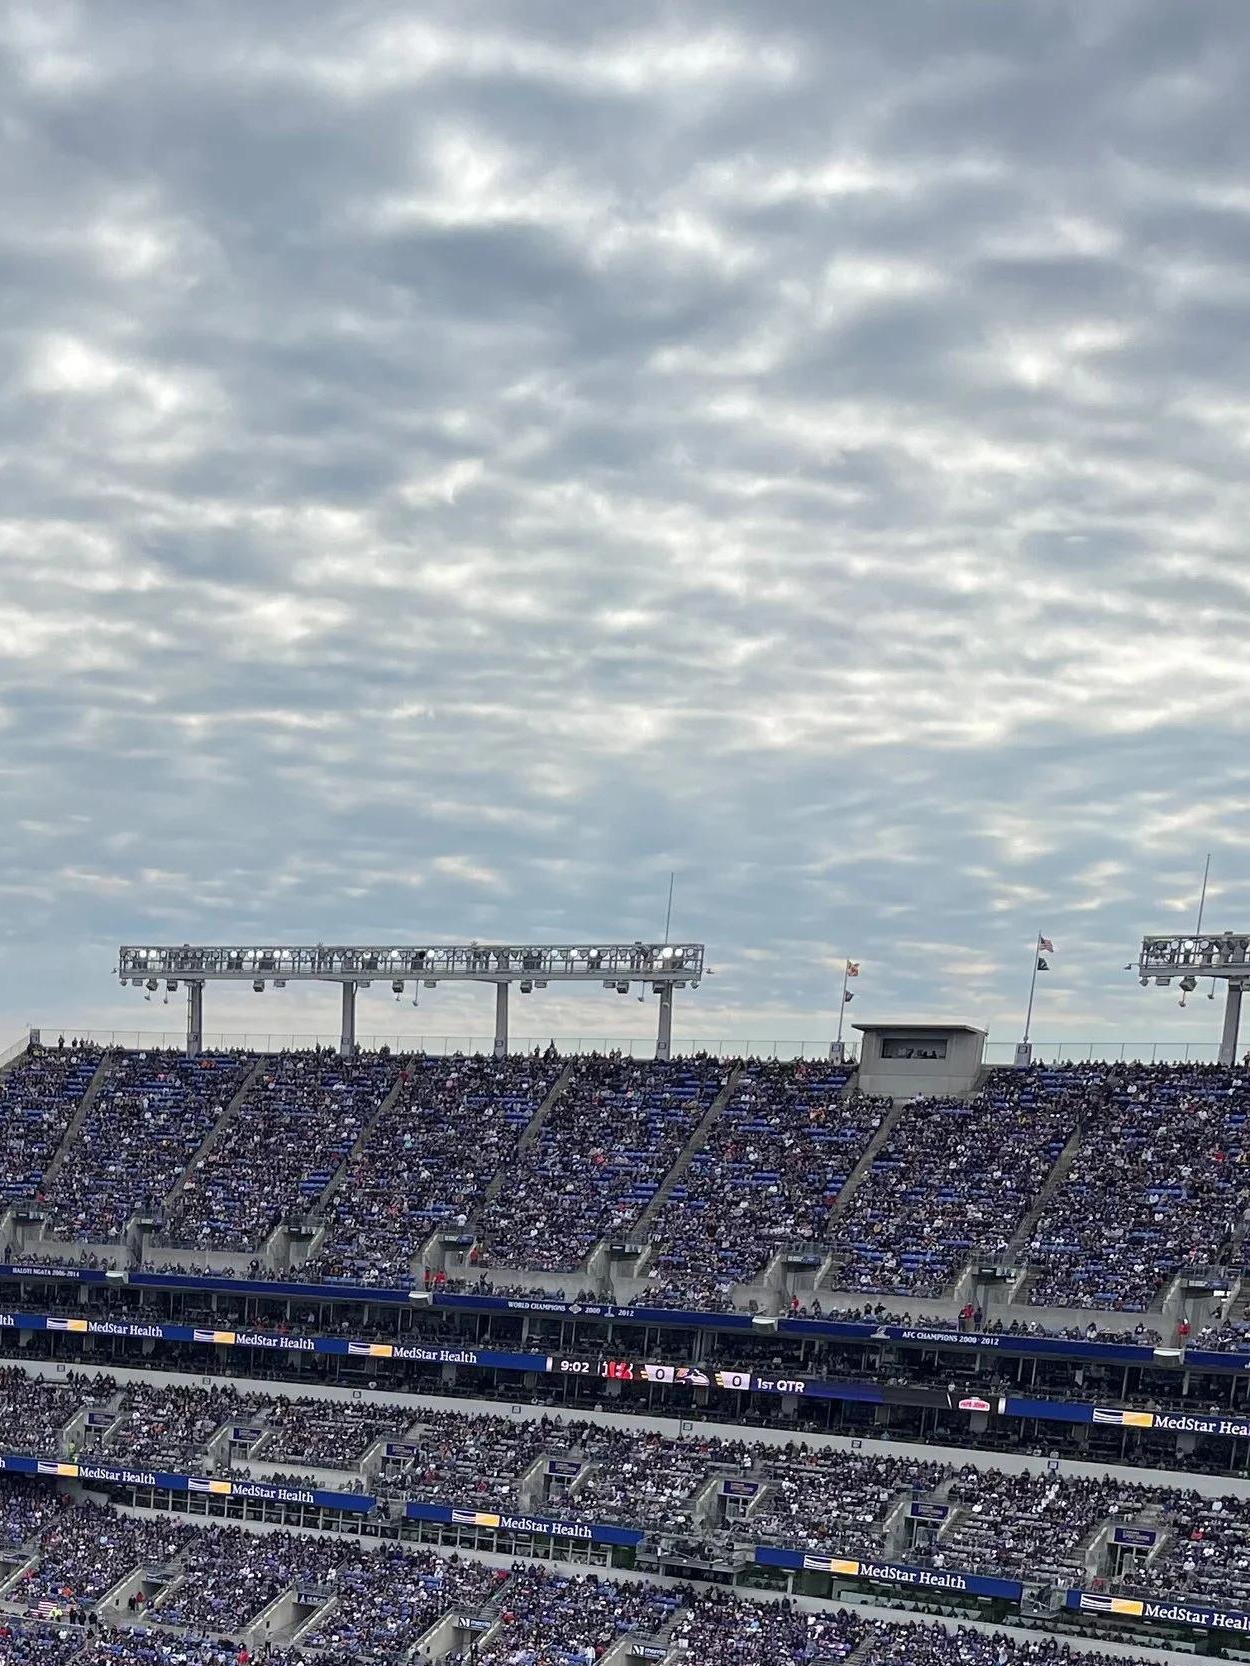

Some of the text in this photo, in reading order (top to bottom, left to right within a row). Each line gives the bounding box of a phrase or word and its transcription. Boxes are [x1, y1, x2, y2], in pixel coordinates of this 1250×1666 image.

[508, 1301, 530, 1309] WORLD
[531, 1302, 566, 1312] CHAMPIONS
[618, 1309, 635, 1317] 2012
[88, 1322, 163, 1338] MedStar Health
[902, 1331, 916, 1339] AFC
[916, 1333, 958, 1343] CHAMPIONS
[980, 1337, 1000, 1345] 2012
[236, 1334, 315, 1350] MedStar Health
[393, 1347, 477, 1364] MedStar Health
[560, 1360, 805, 1393] 9:02 0 0 1ST QTR
[1154, 1415, 1217, 1432] MedStar
[79, 1467, 156, 1485] MedStar Health
[232, 1484, 314, 1504] MedStar Health
[501, 1516, 592, 1539] MedStar Health
[860, 1563, 967, 1590] MedStar Health
[1145, 1603, 1250, 1631] MedStar Heal
